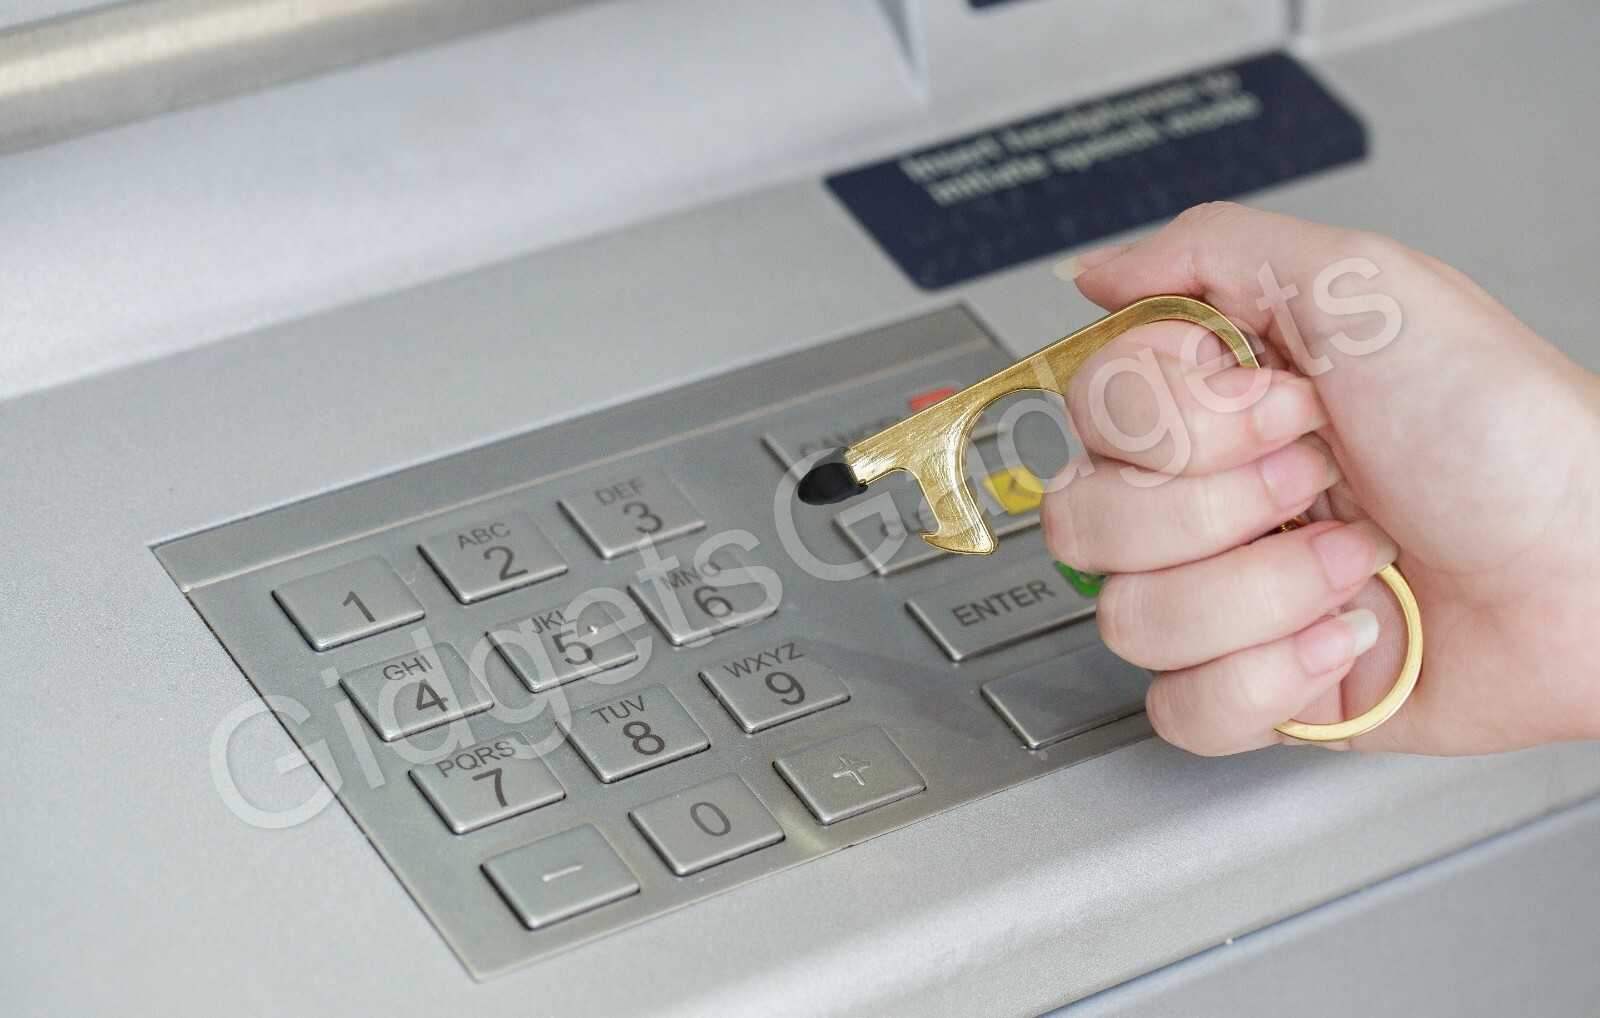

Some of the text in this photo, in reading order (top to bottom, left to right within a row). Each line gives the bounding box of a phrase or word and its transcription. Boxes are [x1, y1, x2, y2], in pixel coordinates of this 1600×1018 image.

[594, 476, 647, 506] DEF
[623, 501, 664, 534] 3
[457, 522, 511, 549] ABC
[483, 545, 529, 581] 2
[659, 561, 721, 590] MNO
[342, 590, 376, 623] 1
[692, 585, 734, 617] 6
[952, 578, 1057, 628] ENTER
[531, 609, 577, 635] JKL
[552, 628, 594, 665] 5
[723, 642, 804, 679] WXYZ
[382, 657, 434, 681] GHI
[415, 678, 449, 713] 4
[765, 671, 806, 705] 9
[590, 694, 646, 724] TUV
[622, 720, 666, 756] 8
[436, 740, 516, 777] PQRS
[472, 767, 508, 808] 7
[689, 801, 732, 837] 0
